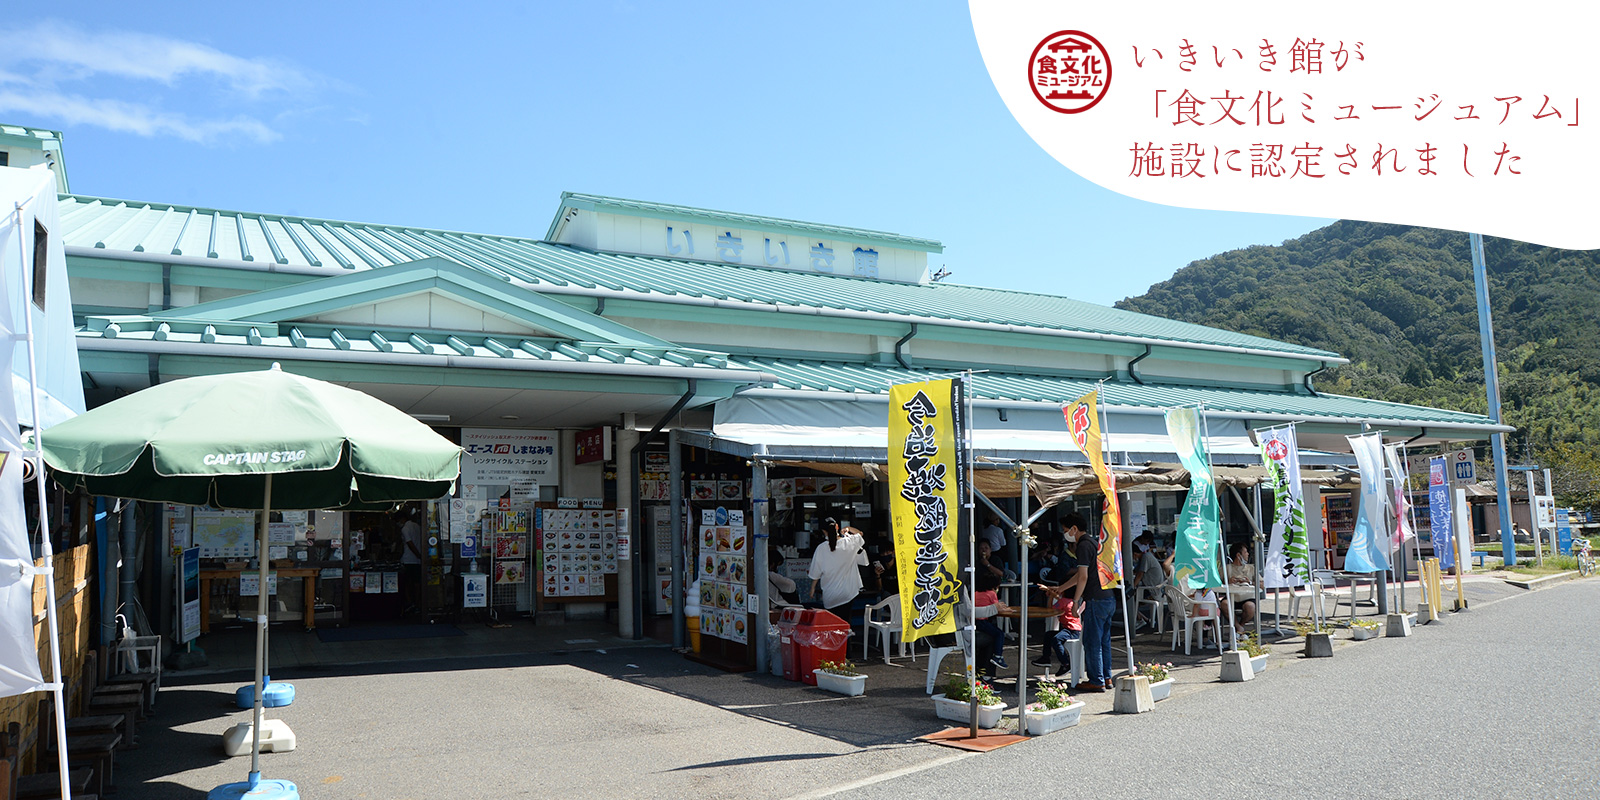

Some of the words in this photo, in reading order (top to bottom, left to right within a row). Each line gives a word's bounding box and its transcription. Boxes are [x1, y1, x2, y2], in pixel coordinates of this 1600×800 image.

[666, 225, 880, 279] いきいき館
[467, 444, 493, 454] エース
[494, 444, 511, 454] JTB
[513, 445, 554, 455] しまなみ号
[203, 451, 267, 466] CAPTAIN
[270, 450, 306, 464] STAG
